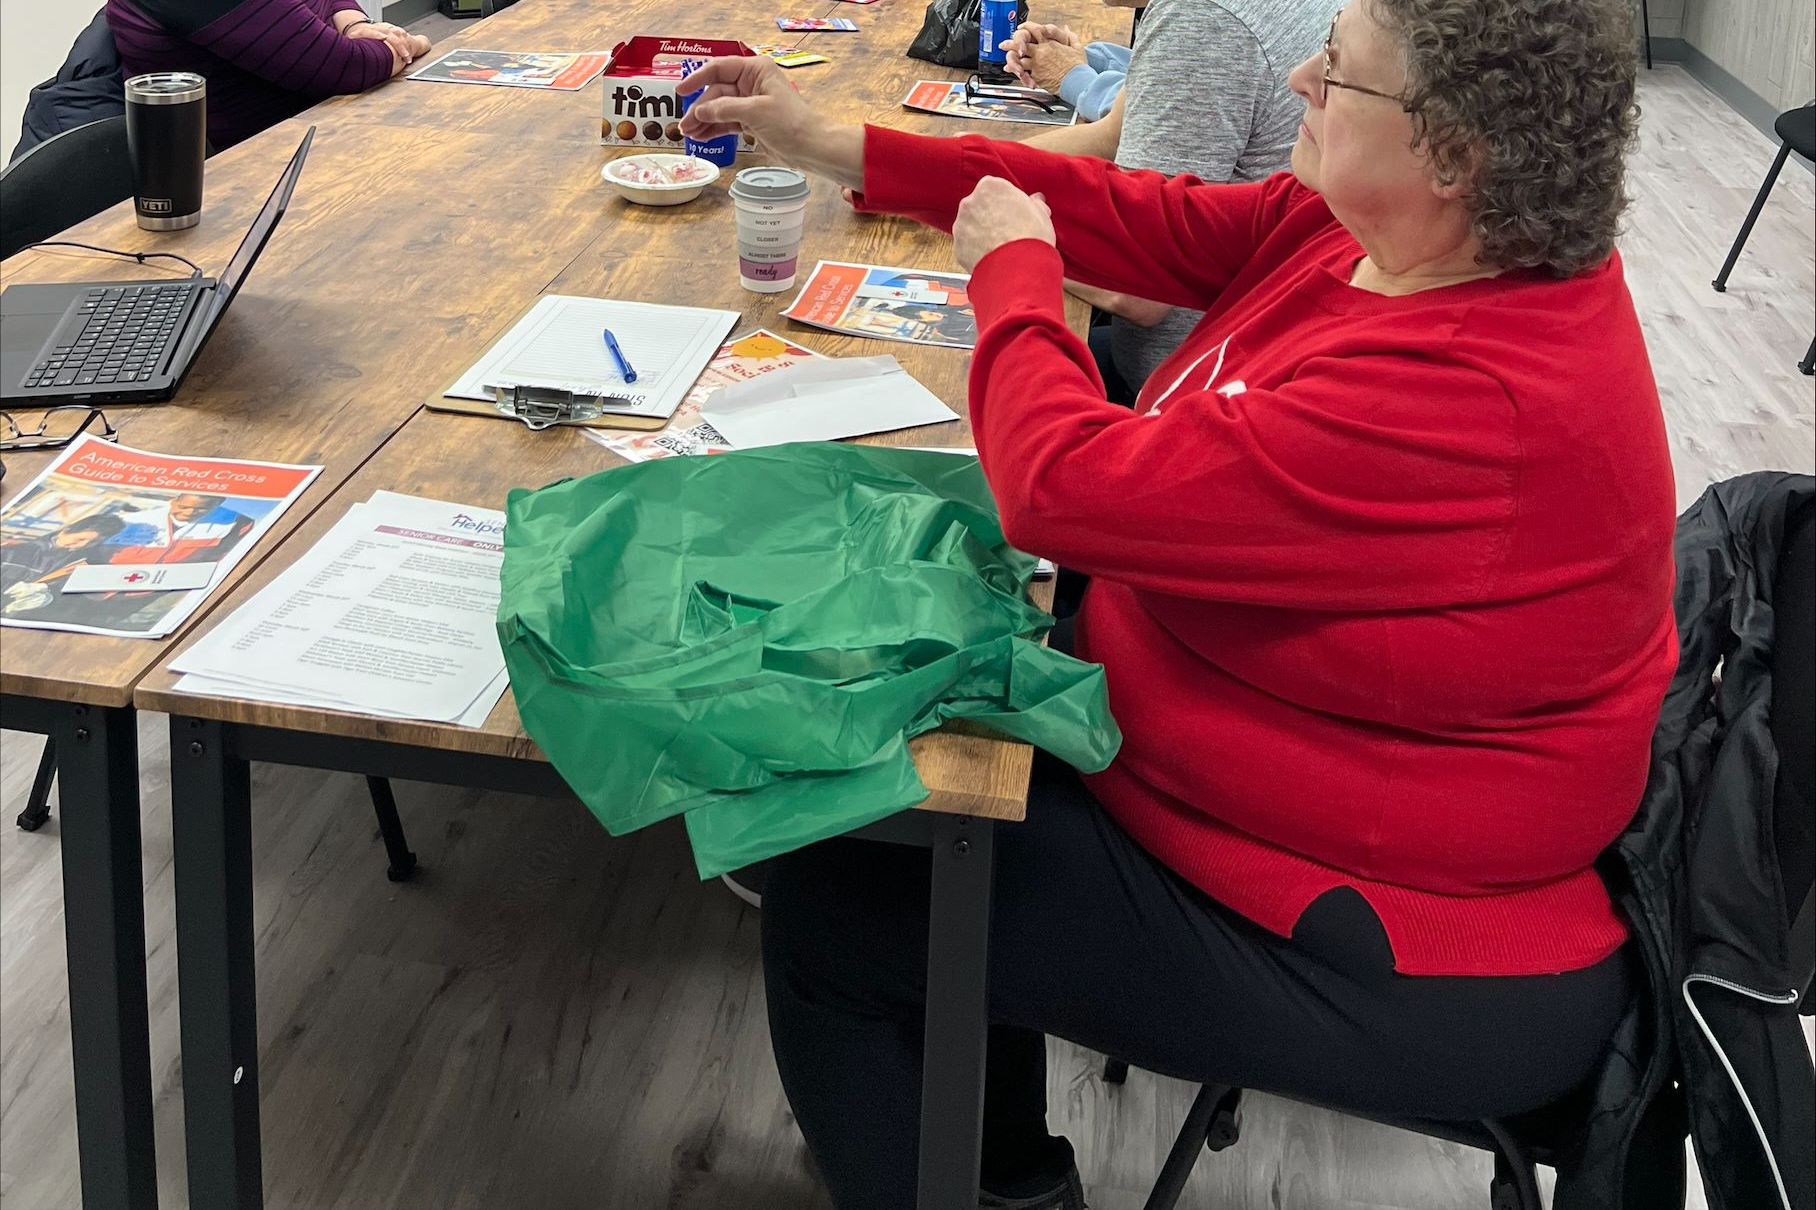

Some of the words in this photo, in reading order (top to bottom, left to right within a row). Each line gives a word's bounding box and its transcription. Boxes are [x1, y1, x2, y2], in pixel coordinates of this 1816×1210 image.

[659, 40, 676, 52] Tim
[676, 40, 712, 54] Hortons
[698, 145, 724, 154] Years!
[142, 200, 168, 210] YETI
[79, 451, 168, 476] American
[171, 467, 210, 480] Red
[214, 469, 267, 484] Cross
[68, 462, 122, 481] Guide
[128, 473, 147, 484] to
[150, 474, 230, 492] Services
[451, 518, 504, 535] Helpe
[472, 542, 503, 550] ONLY
